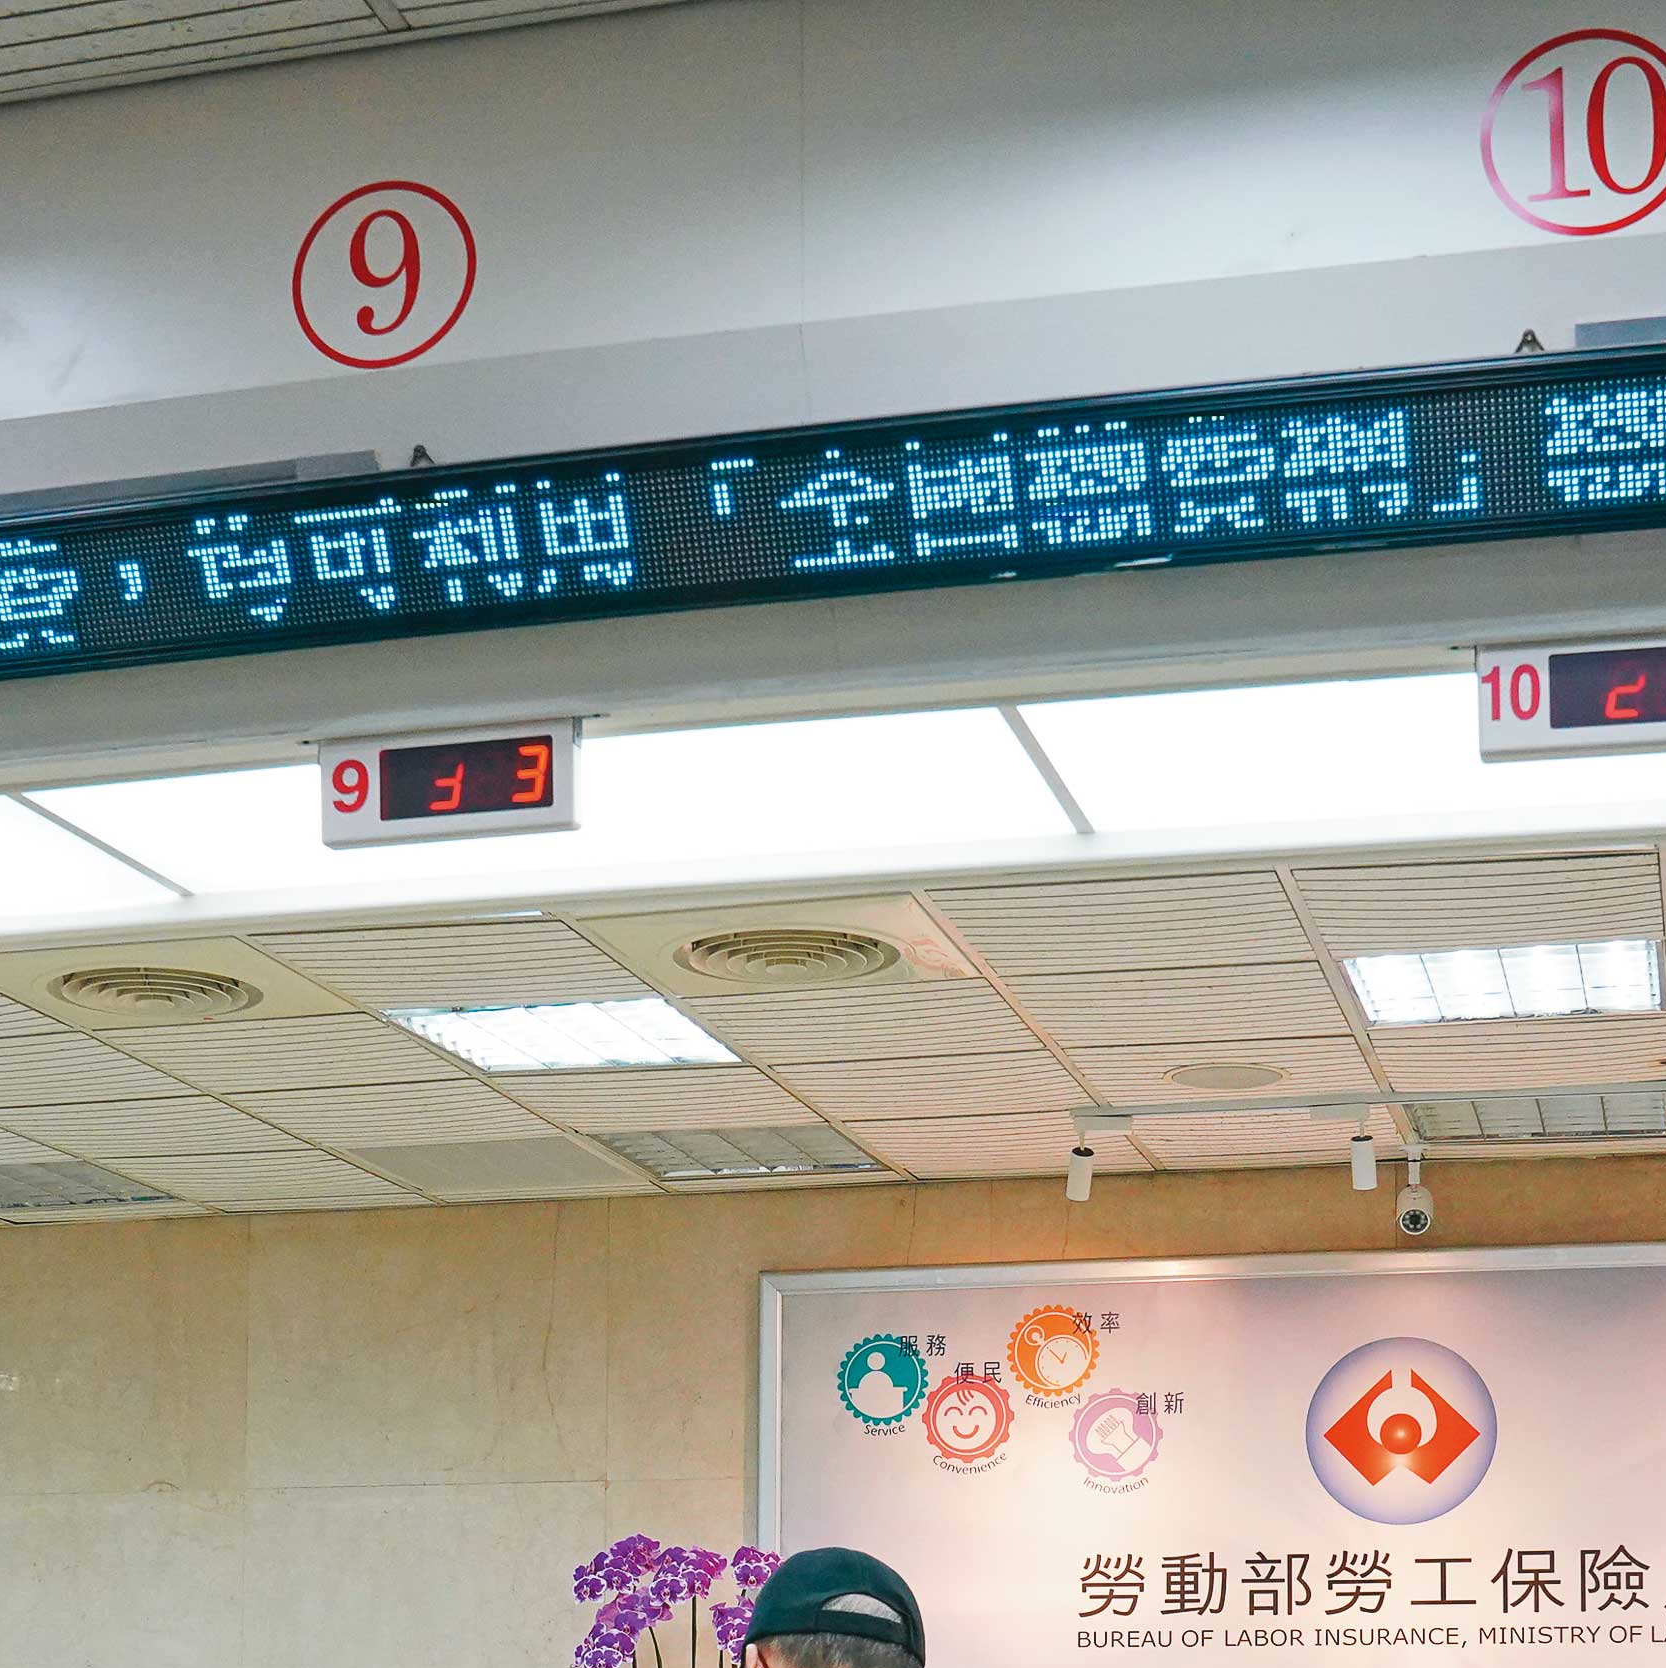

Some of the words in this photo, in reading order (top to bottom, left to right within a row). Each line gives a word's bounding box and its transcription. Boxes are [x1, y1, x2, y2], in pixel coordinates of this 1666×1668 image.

[348, 209, 421, 336] 9
[1481, 664, 1541, 722] 10
[333, 759, 370, 813] 9
[1072, 1312, 1120, 1334] 效率
[898, 1334, 947, 1357] 服務
[954, 1361, 1002, 1385] 便民
[1025, 1394, 1081, 1409] Efficiency
[1135, 1392, 1184, 1415] 創新
[863, 1423, 906, 1437] Service
[933, 1452, 1008, 1475] Convenience
[1084, 1476, 1149, 1495] Innovation
[1077, 1629, 1173, 1648] BUREAU
[1182, 1629, 1214, 1648] OF
[1225, 1628, 1305, 1647] LABOR
[1314, 1627, 1467, 1649] INSURANCE,
[1479, 1625, 1600, 1645] MINISTRY
[1609, 1625, 1643, 1643] OF
